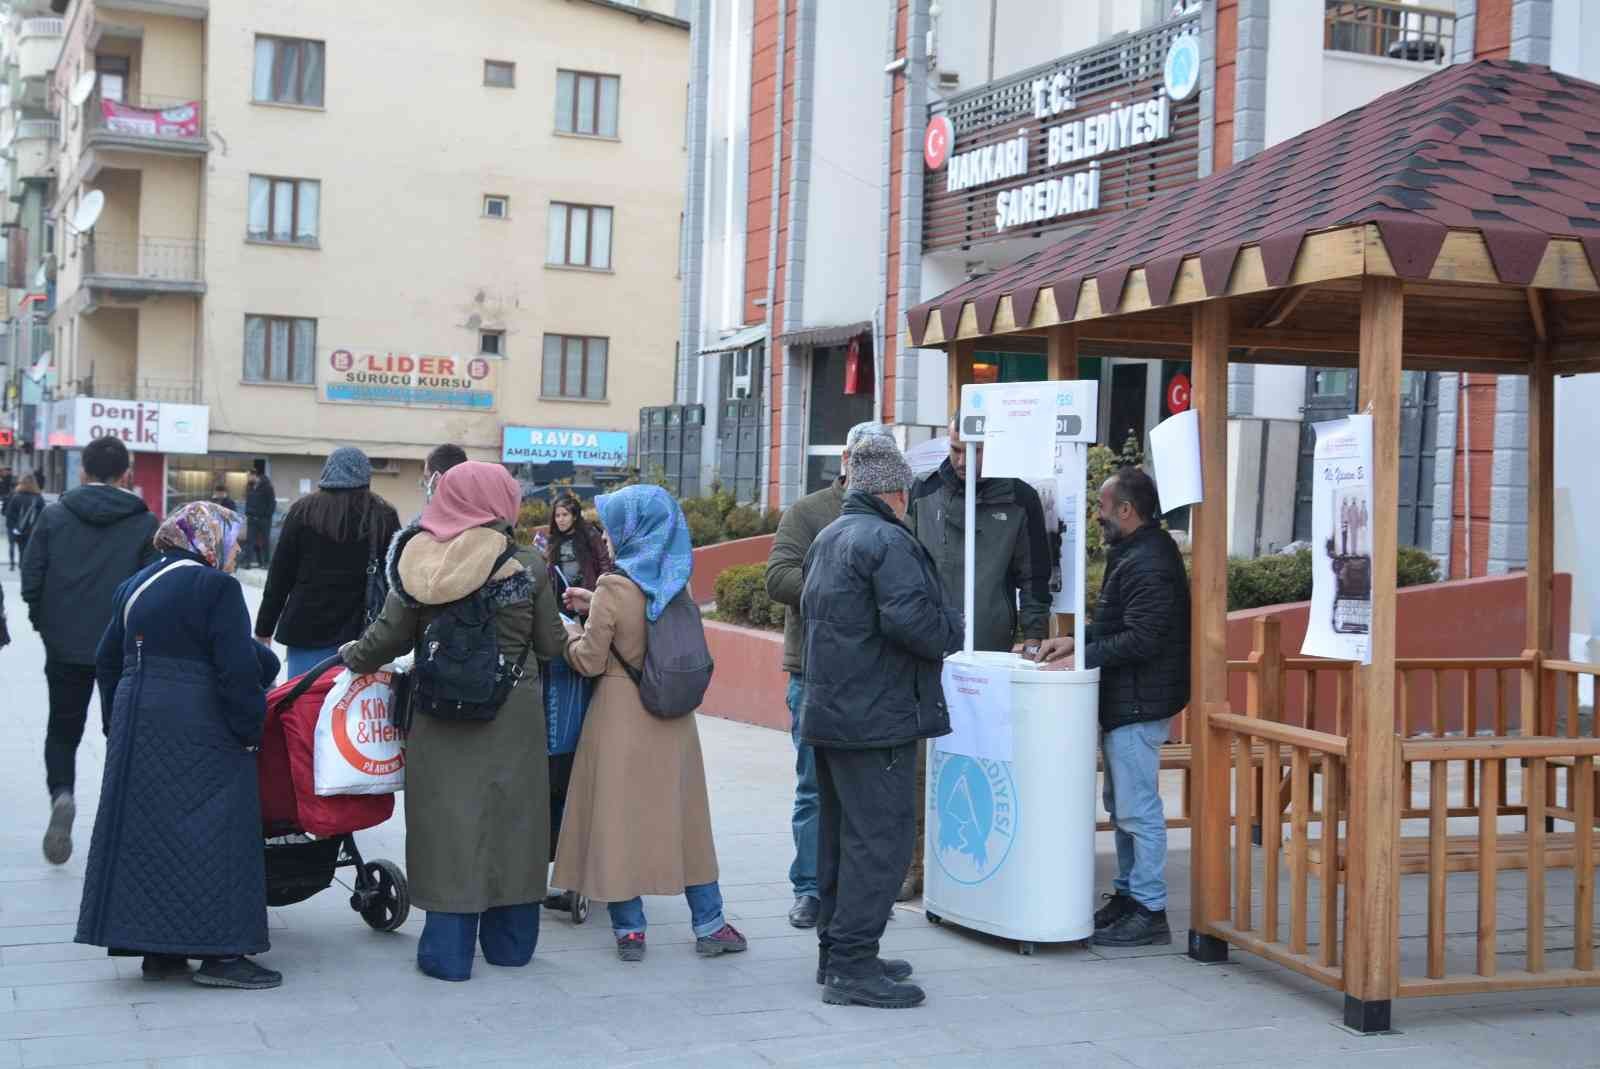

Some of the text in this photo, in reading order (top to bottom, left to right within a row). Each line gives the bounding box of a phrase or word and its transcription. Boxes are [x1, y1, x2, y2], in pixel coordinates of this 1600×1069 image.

[947, 87, 1170, 192] HAKKARİ BELEDİYESİ
[367, 353, 455, 375] LİDER
[345, 371, 472, 389] SÜRÜCÜ KURSU
[91, 402, 160, 426] Deniz
[530, 430, 598, 447] RAVDA
[506, 447, 558, 458] AMBALAJ
[560, 449, 574, 460] VE
